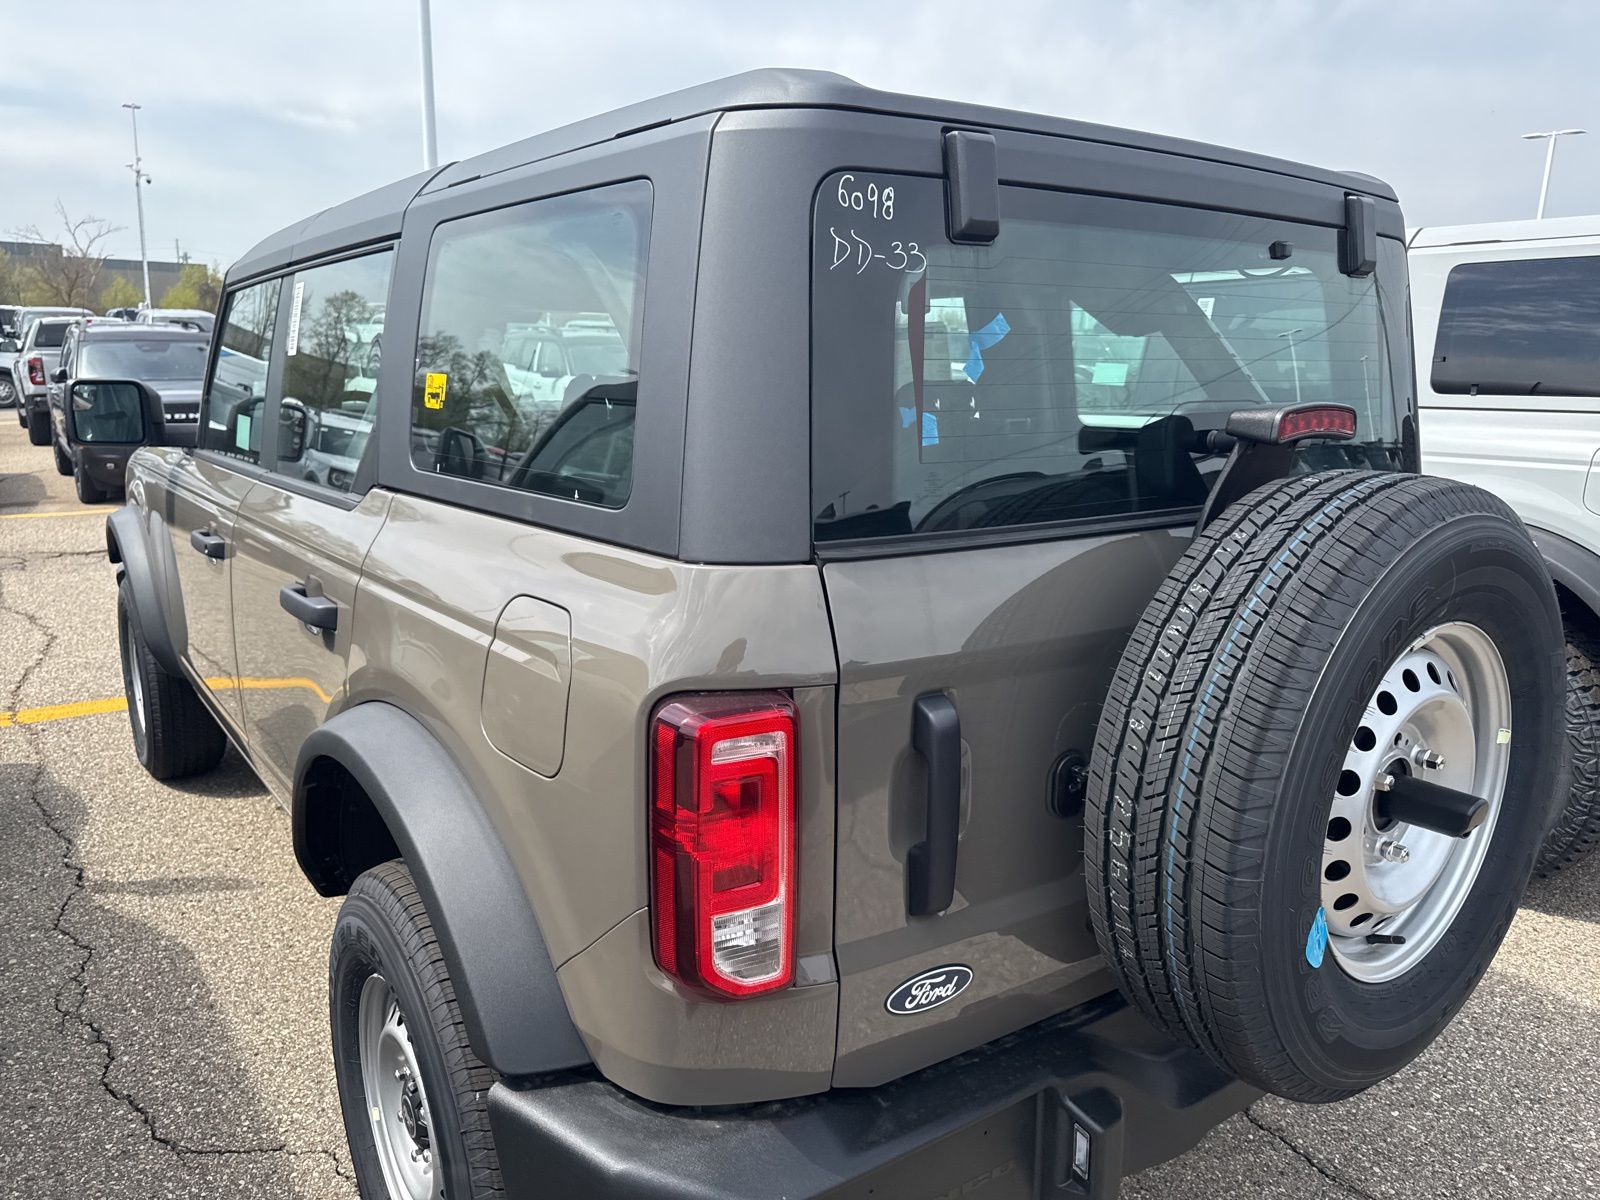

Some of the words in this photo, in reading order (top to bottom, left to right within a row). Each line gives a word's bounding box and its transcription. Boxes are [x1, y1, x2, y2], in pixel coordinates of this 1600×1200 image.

[838, 174, 895, 220] 6098
[829, 226, 927, 275] DD-33
[904, 974, 959, 1009] Ford
